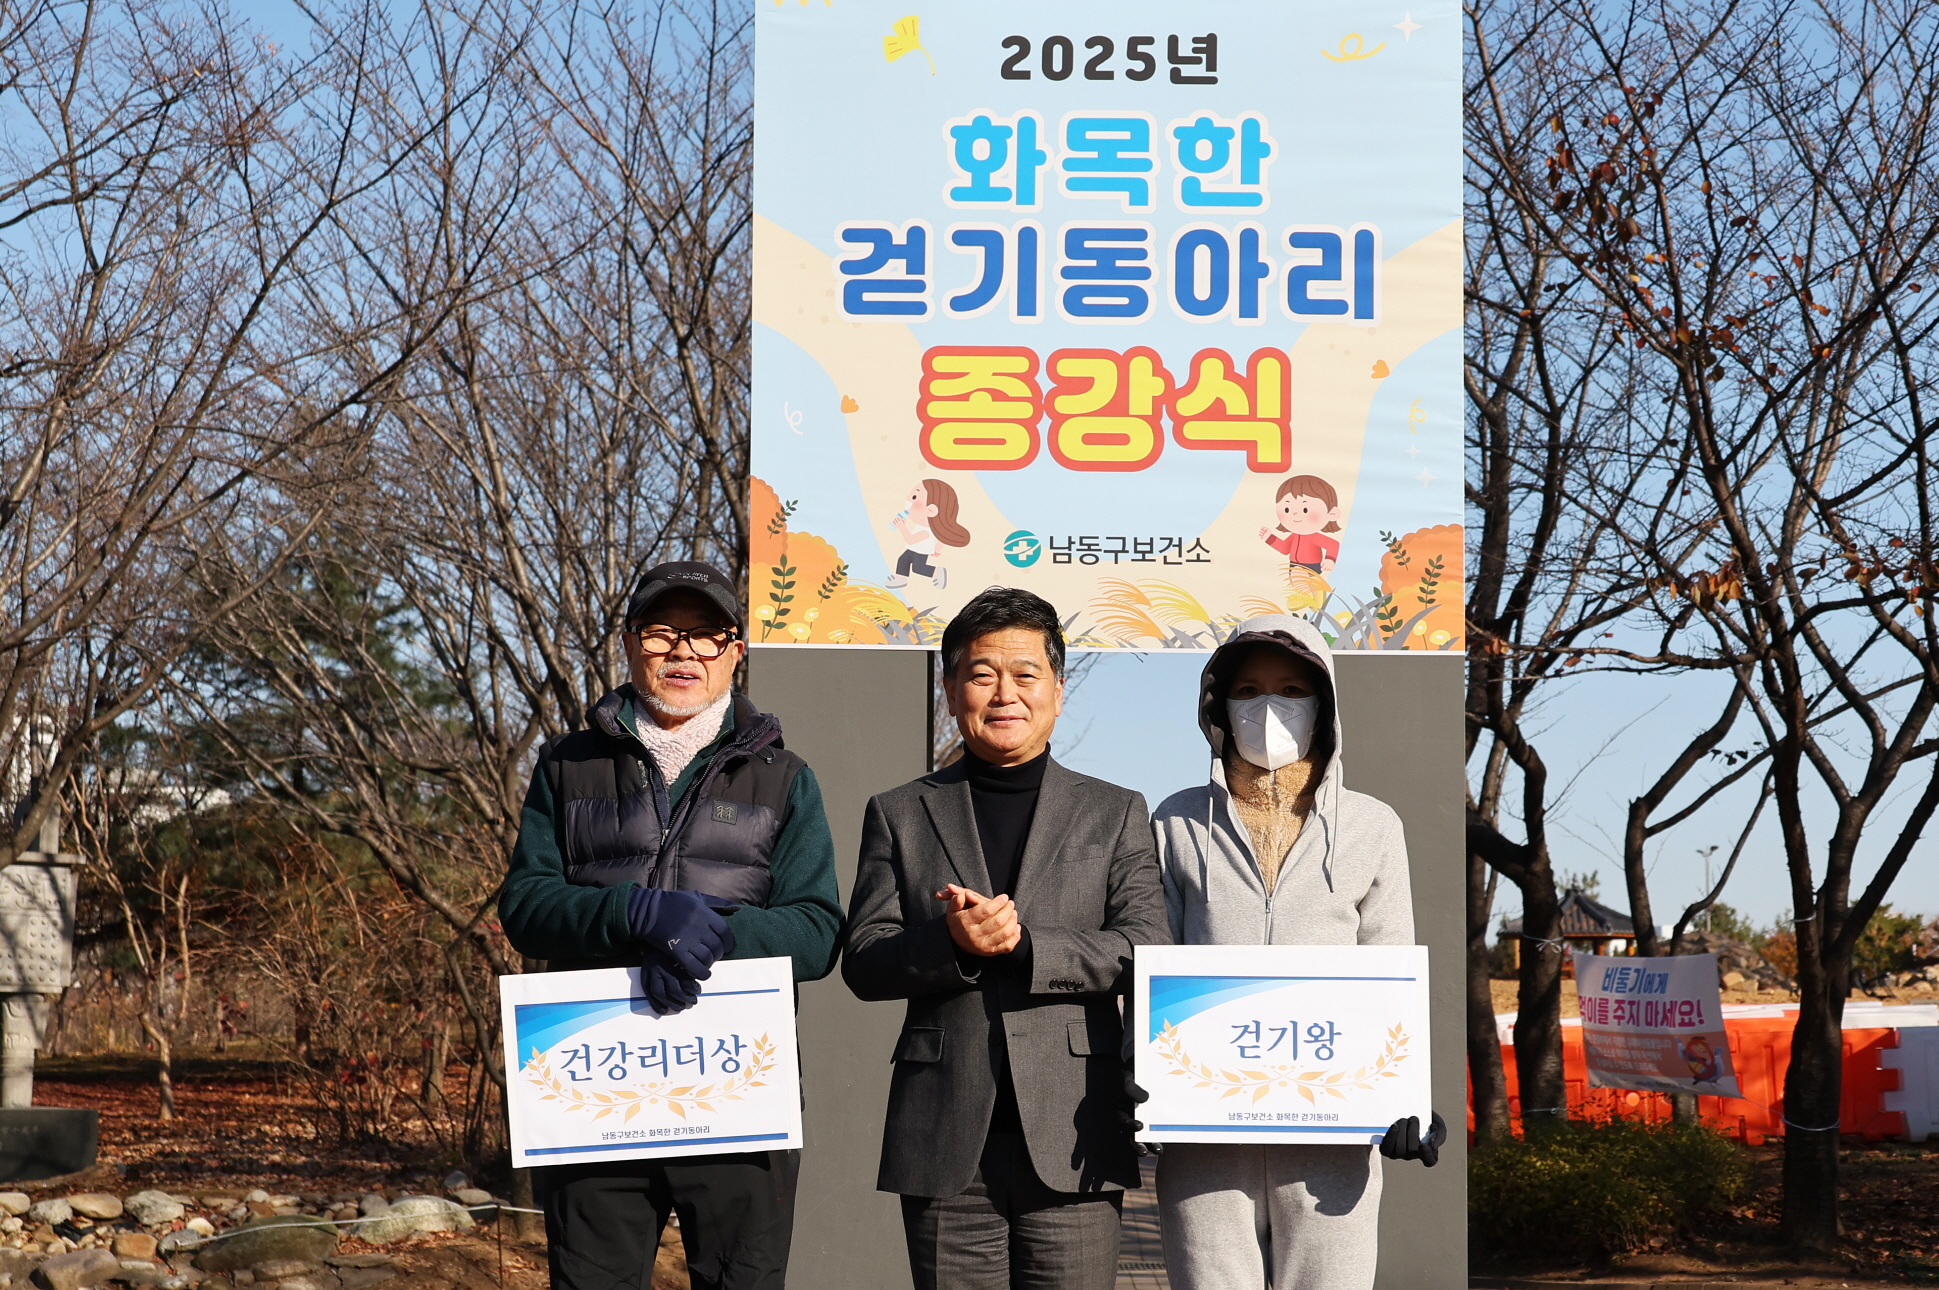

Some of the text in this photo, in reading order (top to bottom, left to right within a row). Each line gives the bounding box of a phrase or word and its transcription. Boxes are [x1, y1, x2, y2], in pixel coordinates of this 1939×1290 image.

[1000, 33, 1219, 85] 2025년
[948, 114, 1272, 208] 화목한
[838, 224, 1376, 320] 걷기동아리
[917, 346, 1291, 472] 종강식
[1049, 535, 1212, 566] 남동구보건소
[1601, 966, 1669, 994] 비둘기에게
[1612, 999, 1640, 1027] 주지
[1645, 999, 1705, 1028] 마세요!
[560, 1034, 748, 1082] 건강리더상
[1229, 1020, 1343, 1061] 걷기왕
[601, 1125, 710, 1140] 남동구보건소 화목한 걷기동아리
[1228, 1112, 1339, 1122] 남동구보건소 화목한 걷기동아리
